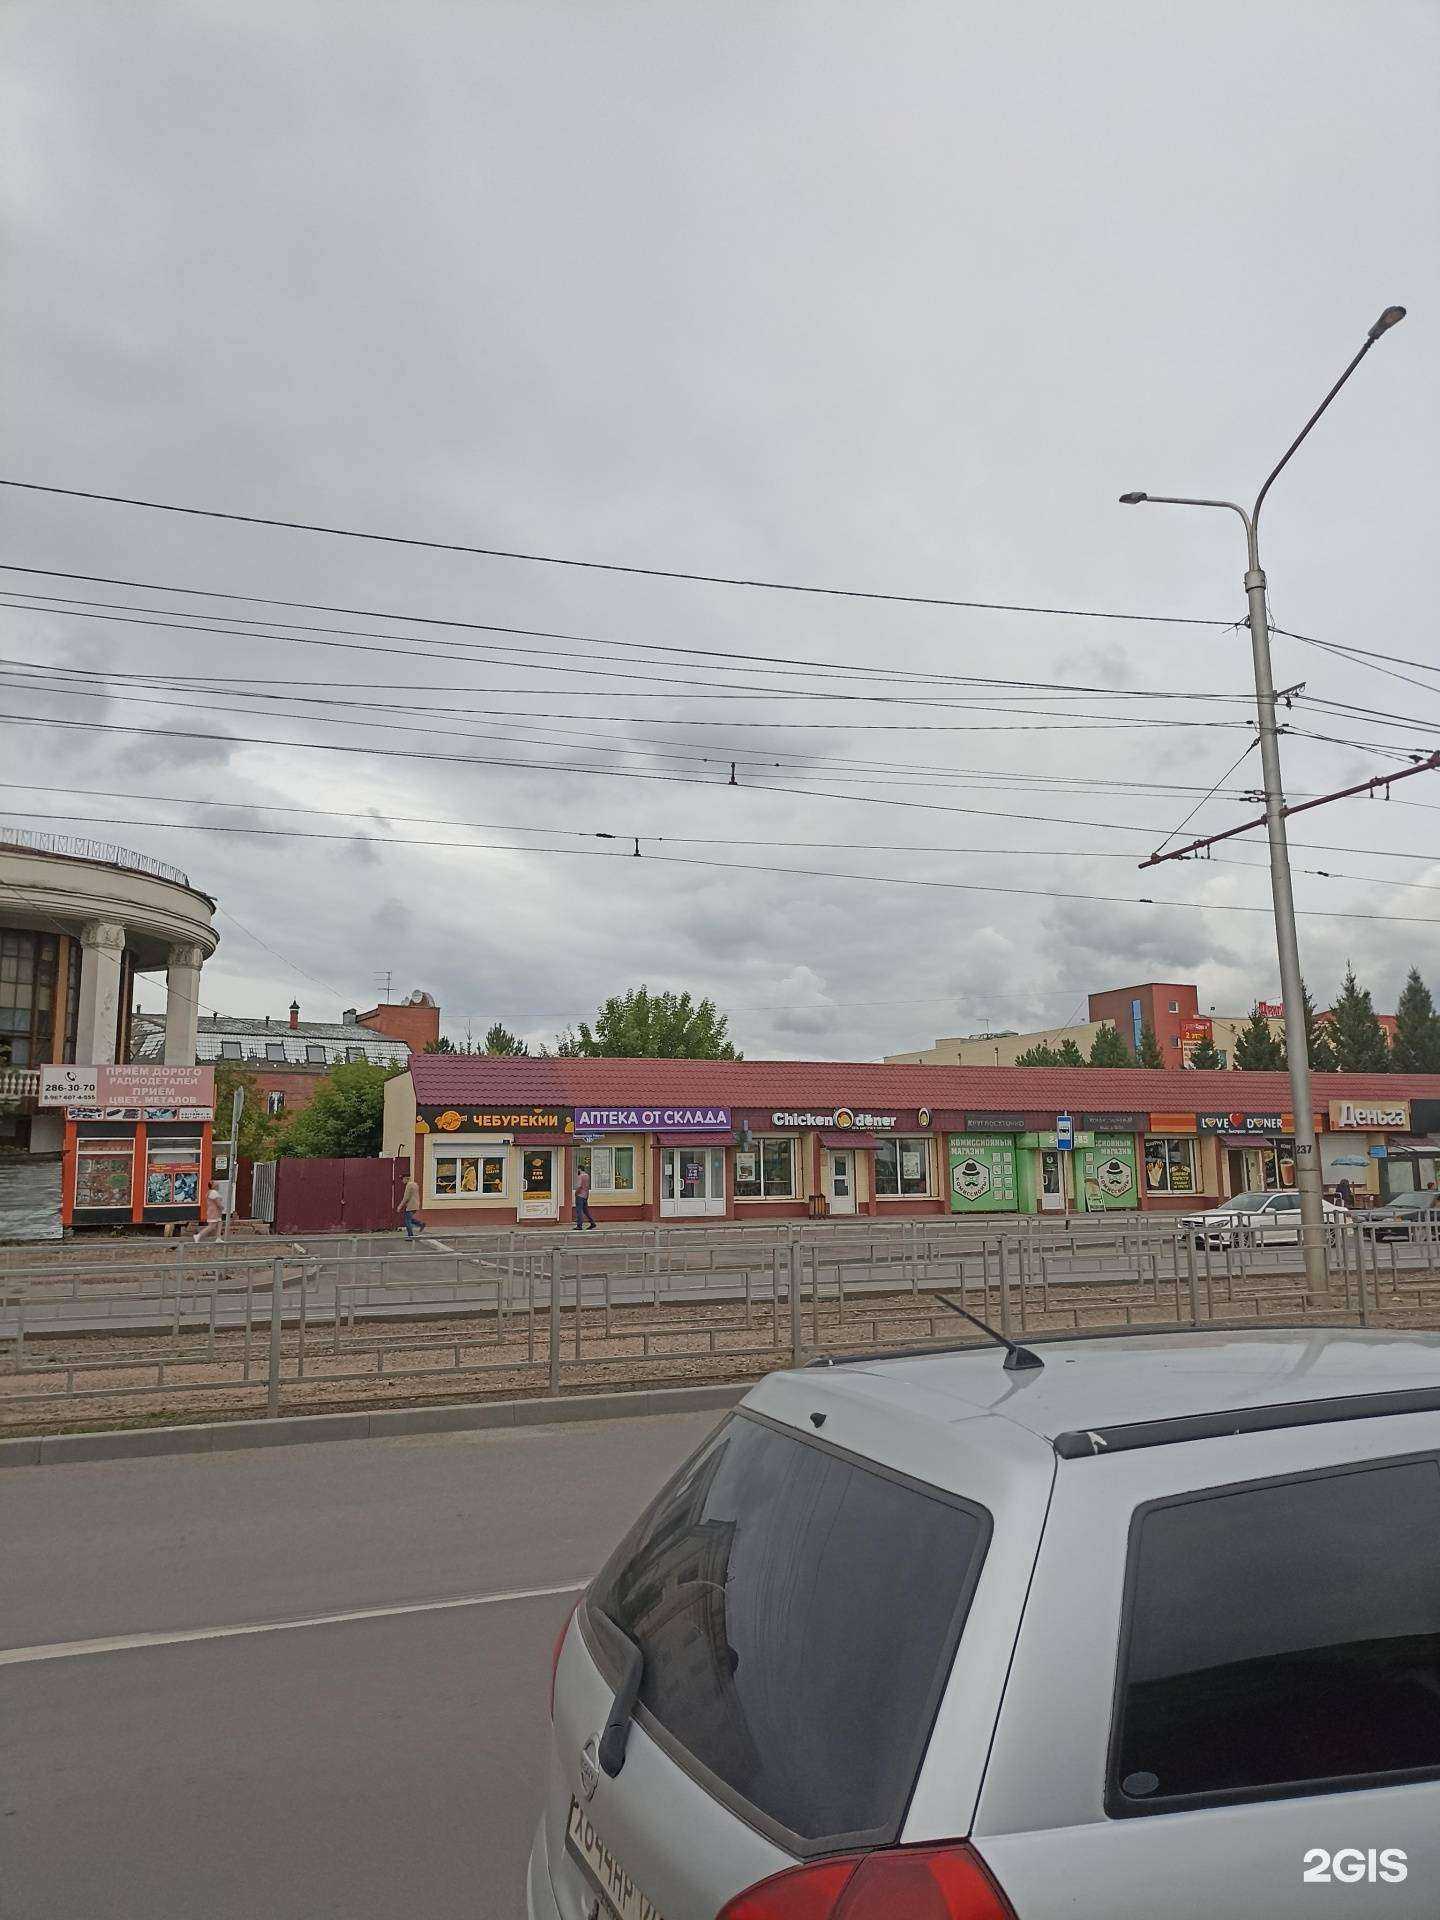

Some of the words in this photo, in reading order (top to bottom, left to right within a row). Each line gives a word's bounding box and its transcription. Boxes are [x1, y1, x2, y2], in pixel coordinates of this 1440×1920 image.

[152, 1067, 202, 1077] ДОРОГО
[45, 1084, 96, 1092] 286-30-70
[132, 1087, 176, 1096] ПРИЕМ
[579, 1111, 639, 1125] АПТЕКА
[641, 1111, 661, 1124] ОТ
[664, 1110, 727, 1124] СКЛАДА
[772, 1112, 834, 1126] Chicken
[1338, 1103, 1405, 1127] Деньга
[473, 1115, 558, 1127] ЧЕБУРЕКМИ
[1296, 1144, 1312, 1154] 237
